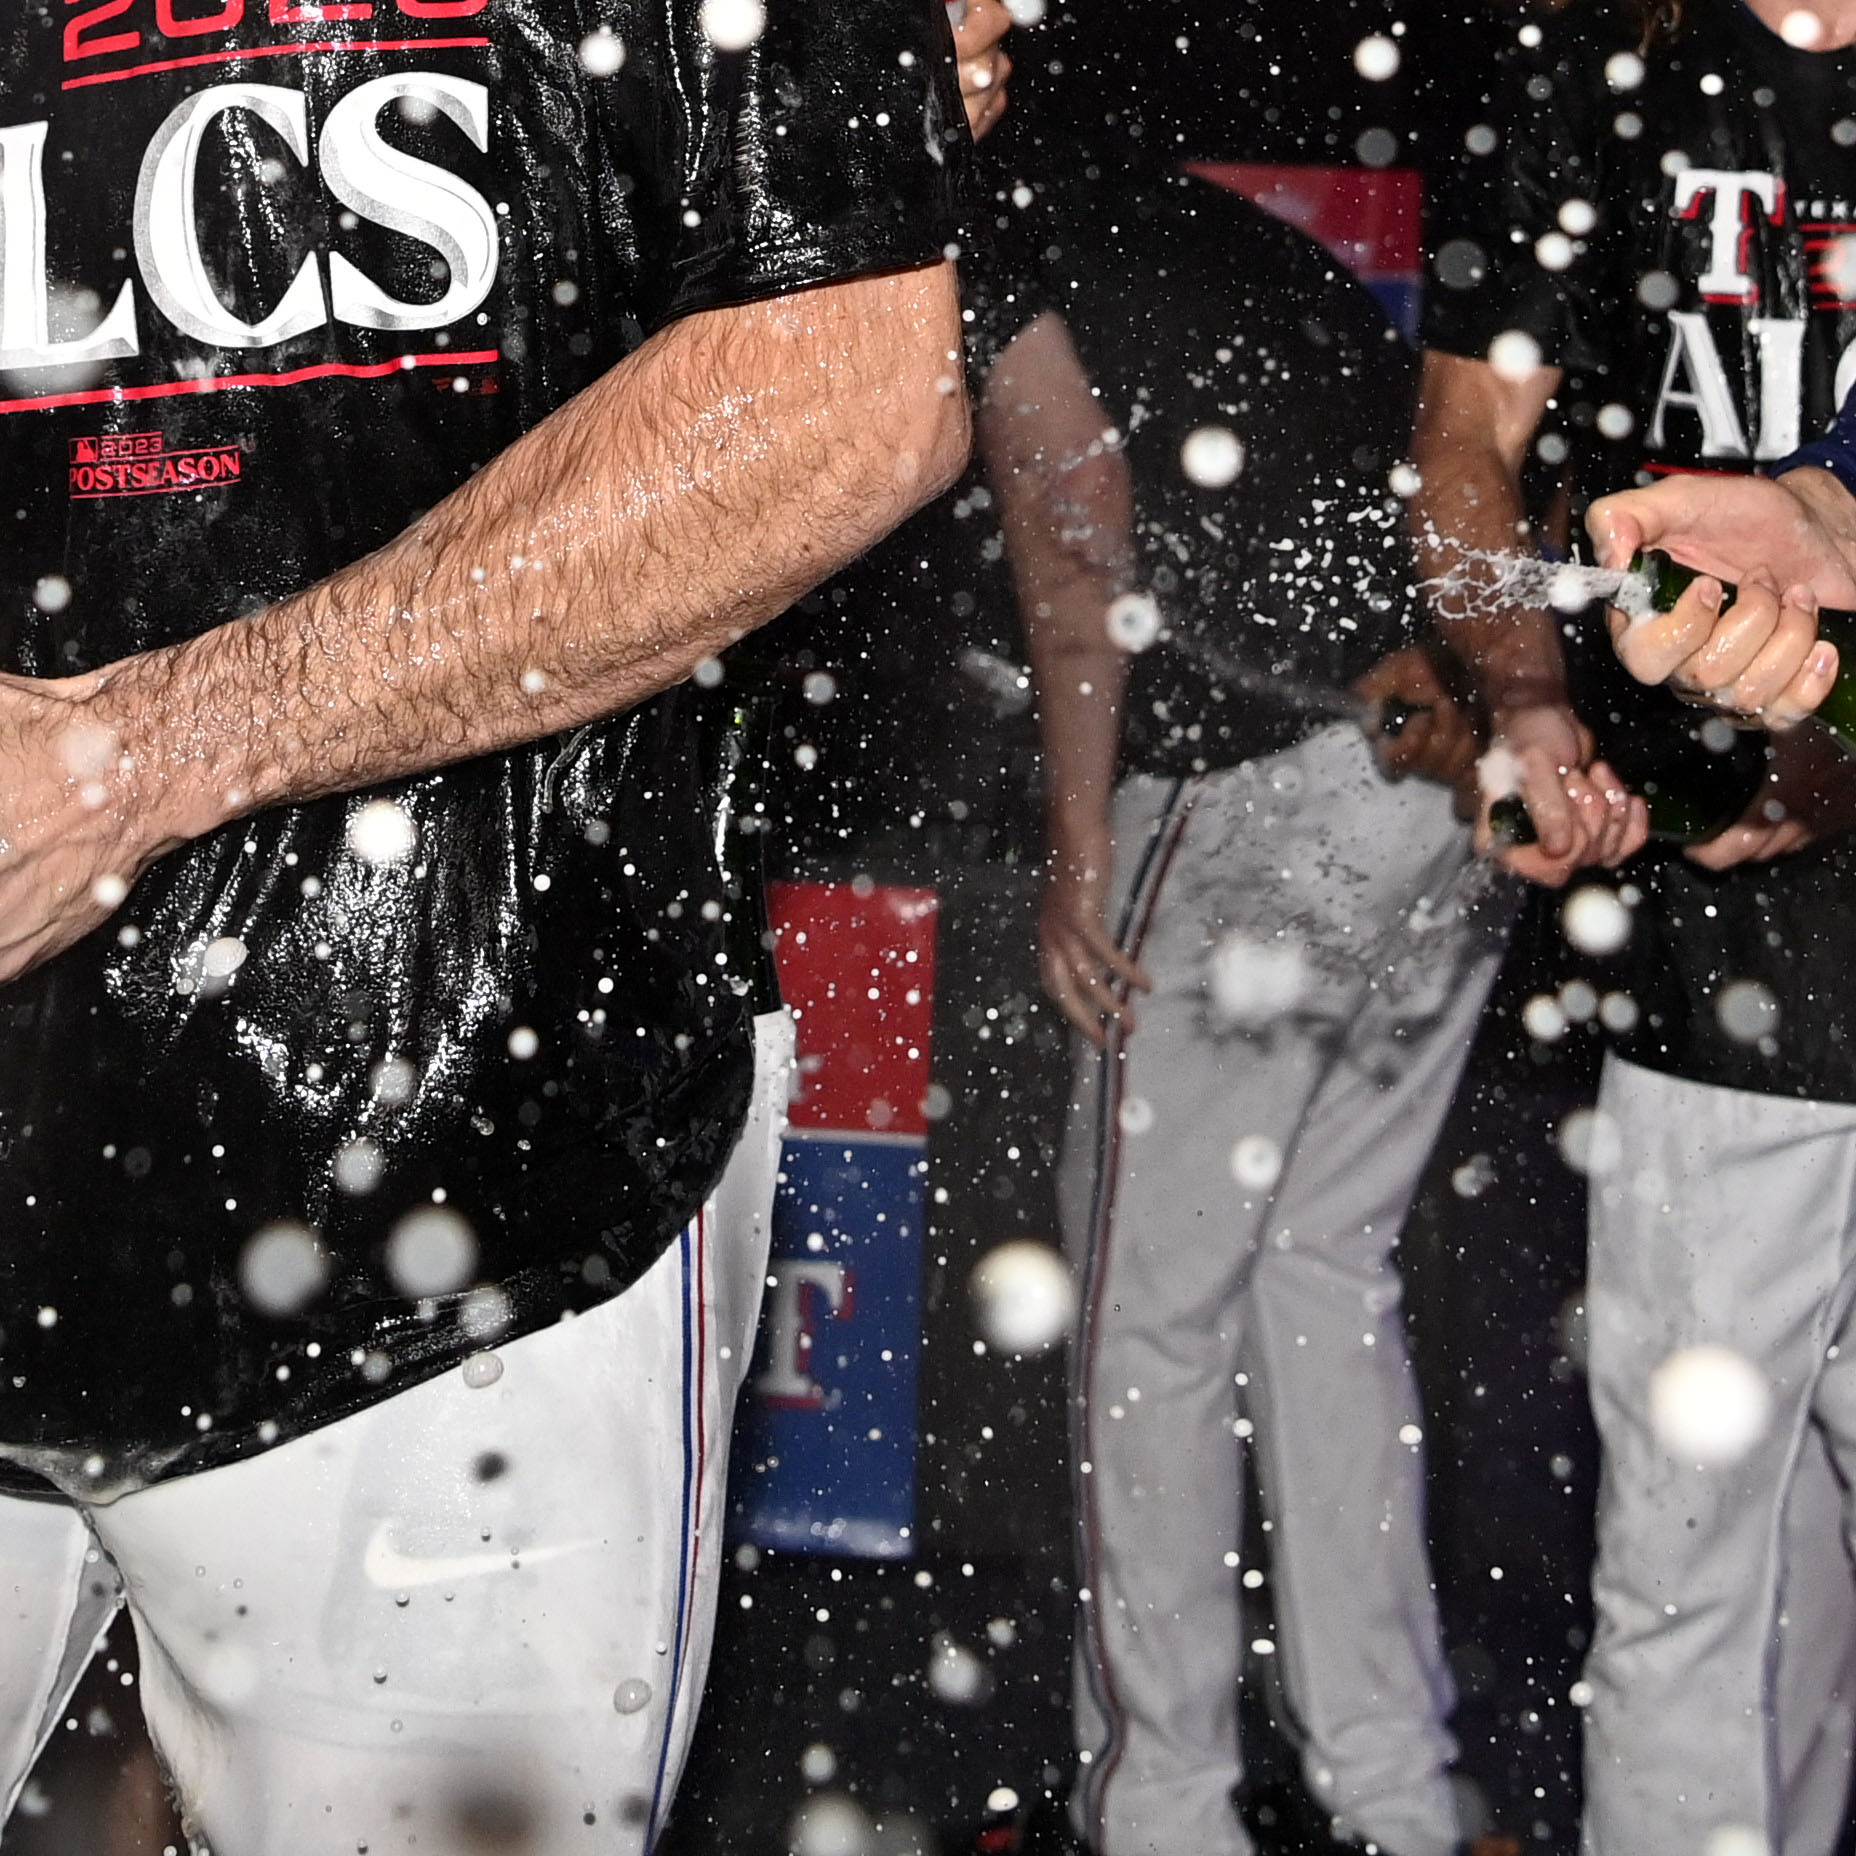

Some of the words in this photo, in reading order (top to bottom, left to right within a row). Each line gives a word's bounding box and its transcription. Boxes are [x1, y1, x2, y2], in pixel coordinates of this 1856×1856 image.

[1673, 168, 1787, 306] T
[100, 436, 163, 457] 2023
[70, 452, 241, 491] POSTSEASON
